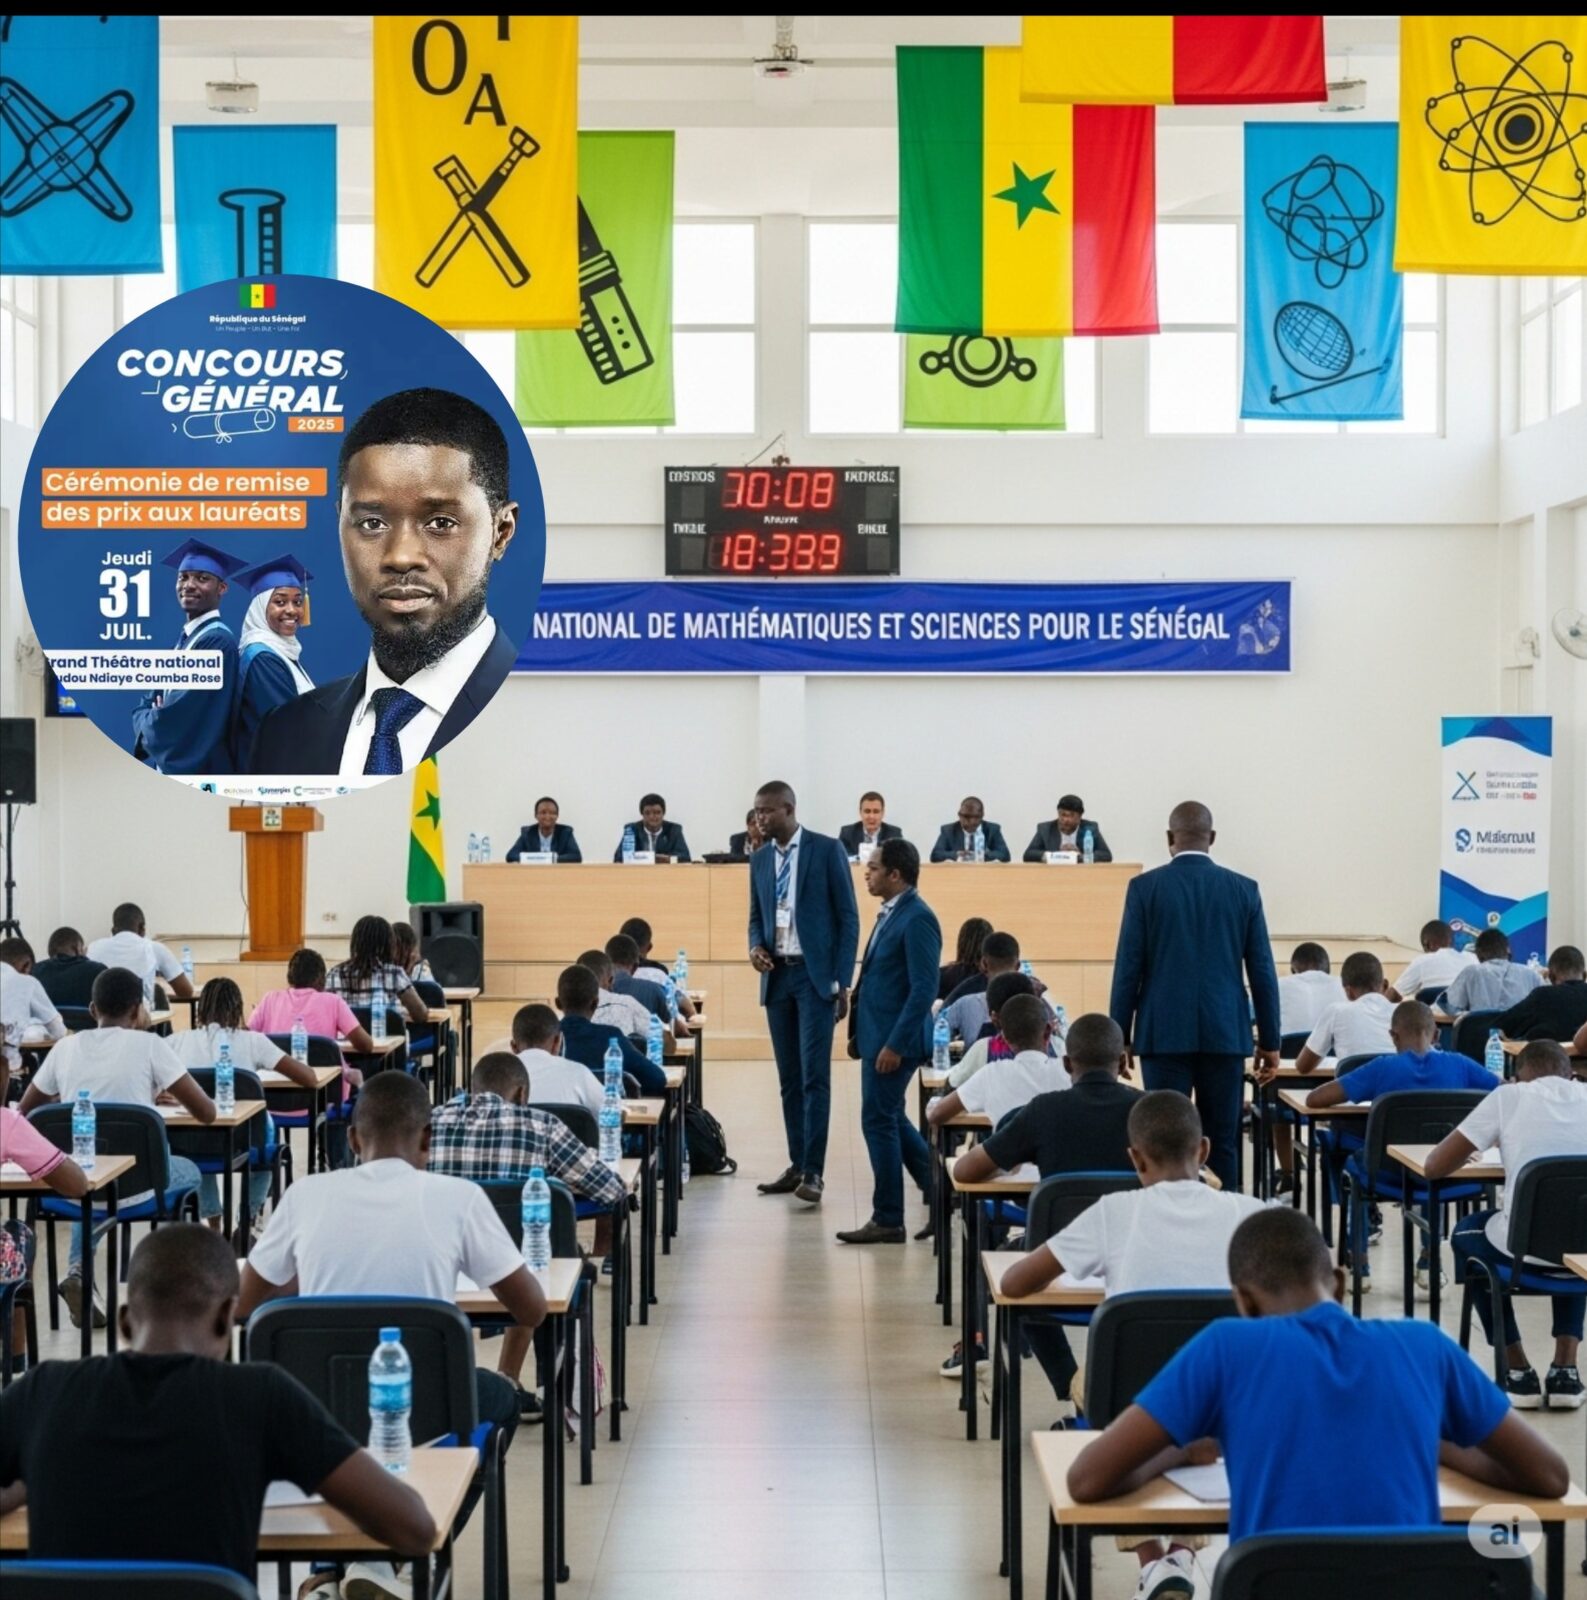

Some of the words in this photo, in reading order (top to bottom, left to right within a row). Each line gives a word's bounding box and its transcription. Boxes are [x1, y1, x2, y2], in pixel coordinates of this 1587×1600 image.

[464, 73, 507, 126] A
[533, 612, 641, 639] NATIONAL
[648, 612, 676, 639] DE
[684, 606, 872, 642] MATHÉMATIQUES
[879, 612, 905, 639] ET
[910, 612, 1021, 640] SCIENCES
[1029, 612, 1091, 640] POUR
[1098, 612, 1123, 640] LE
[1130, 604, 1230, 640] SÉNÉGAL
